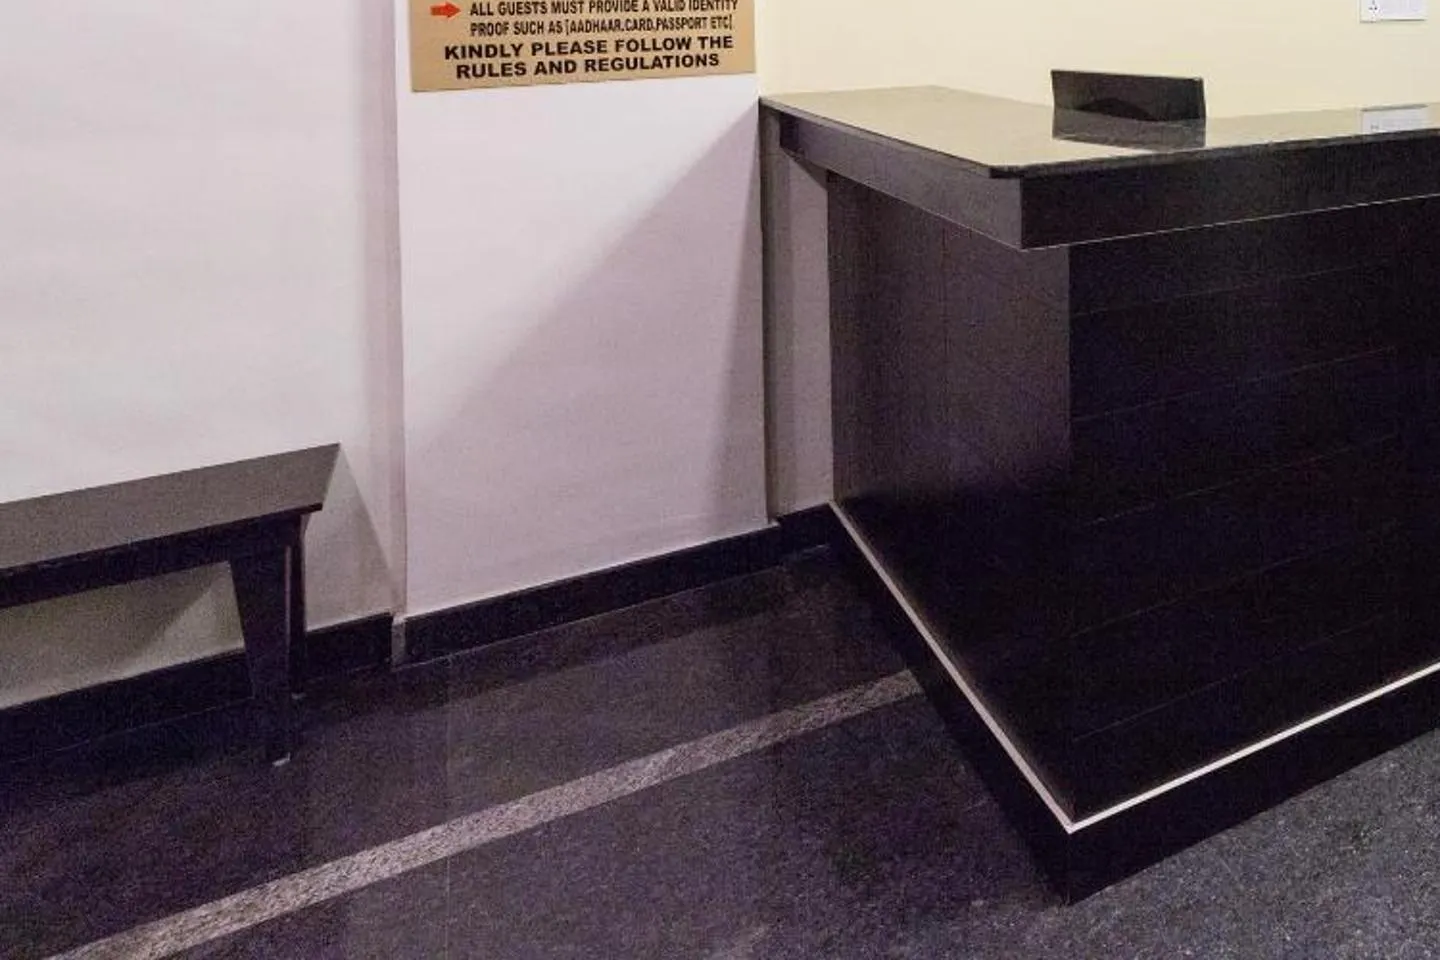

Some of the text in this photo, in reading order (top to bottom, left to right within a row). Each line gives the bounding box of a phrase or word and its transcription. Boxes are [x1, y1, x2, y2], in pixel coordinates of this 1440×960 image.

[470, 2, 494, 16] ALL
[498, 1, 547, 16] GUESTS
[551, 0, 585, 15] MUST
[589, 0, 638, 13] PROVIDE
[642, 0, 650, 12] A
[470, 22, 509, 37] PROOF
[514, 21, 544, 35] SUCH
[548, 20, 562, 34] AS
[445, 36, 733, 60] KINDLY PLEASE FOLLOW THE
[456, 53, 719, 79] RULES AND REGULATIONS
